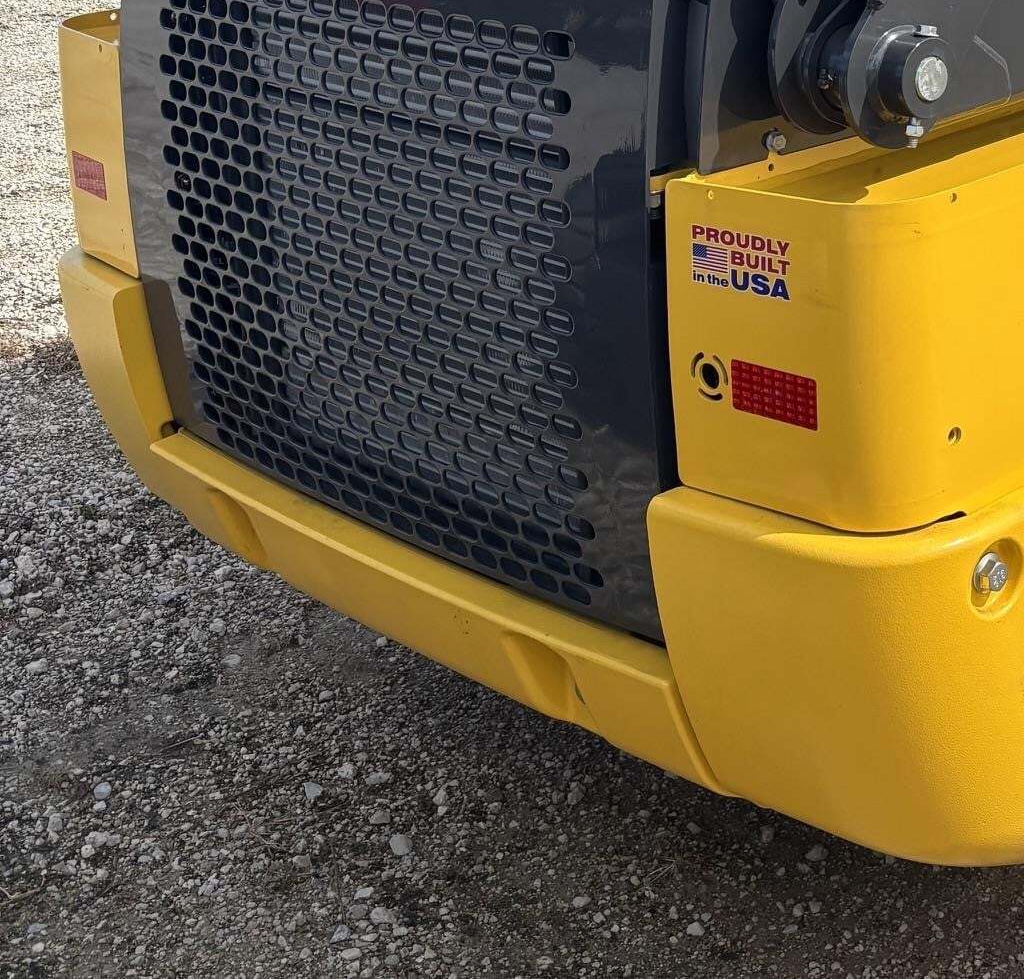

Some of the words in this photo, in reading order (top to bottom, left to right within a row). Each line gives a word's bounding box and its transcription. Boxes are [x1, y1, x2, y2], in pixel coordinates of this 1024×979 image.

[691, 224, 790, 257] PROUDLY
[730, 250, 791, 276] BUILT
[692, 269, 705, 283] in
[706, 273, 730, 288] the
[730, 268, 791, 301] USA
